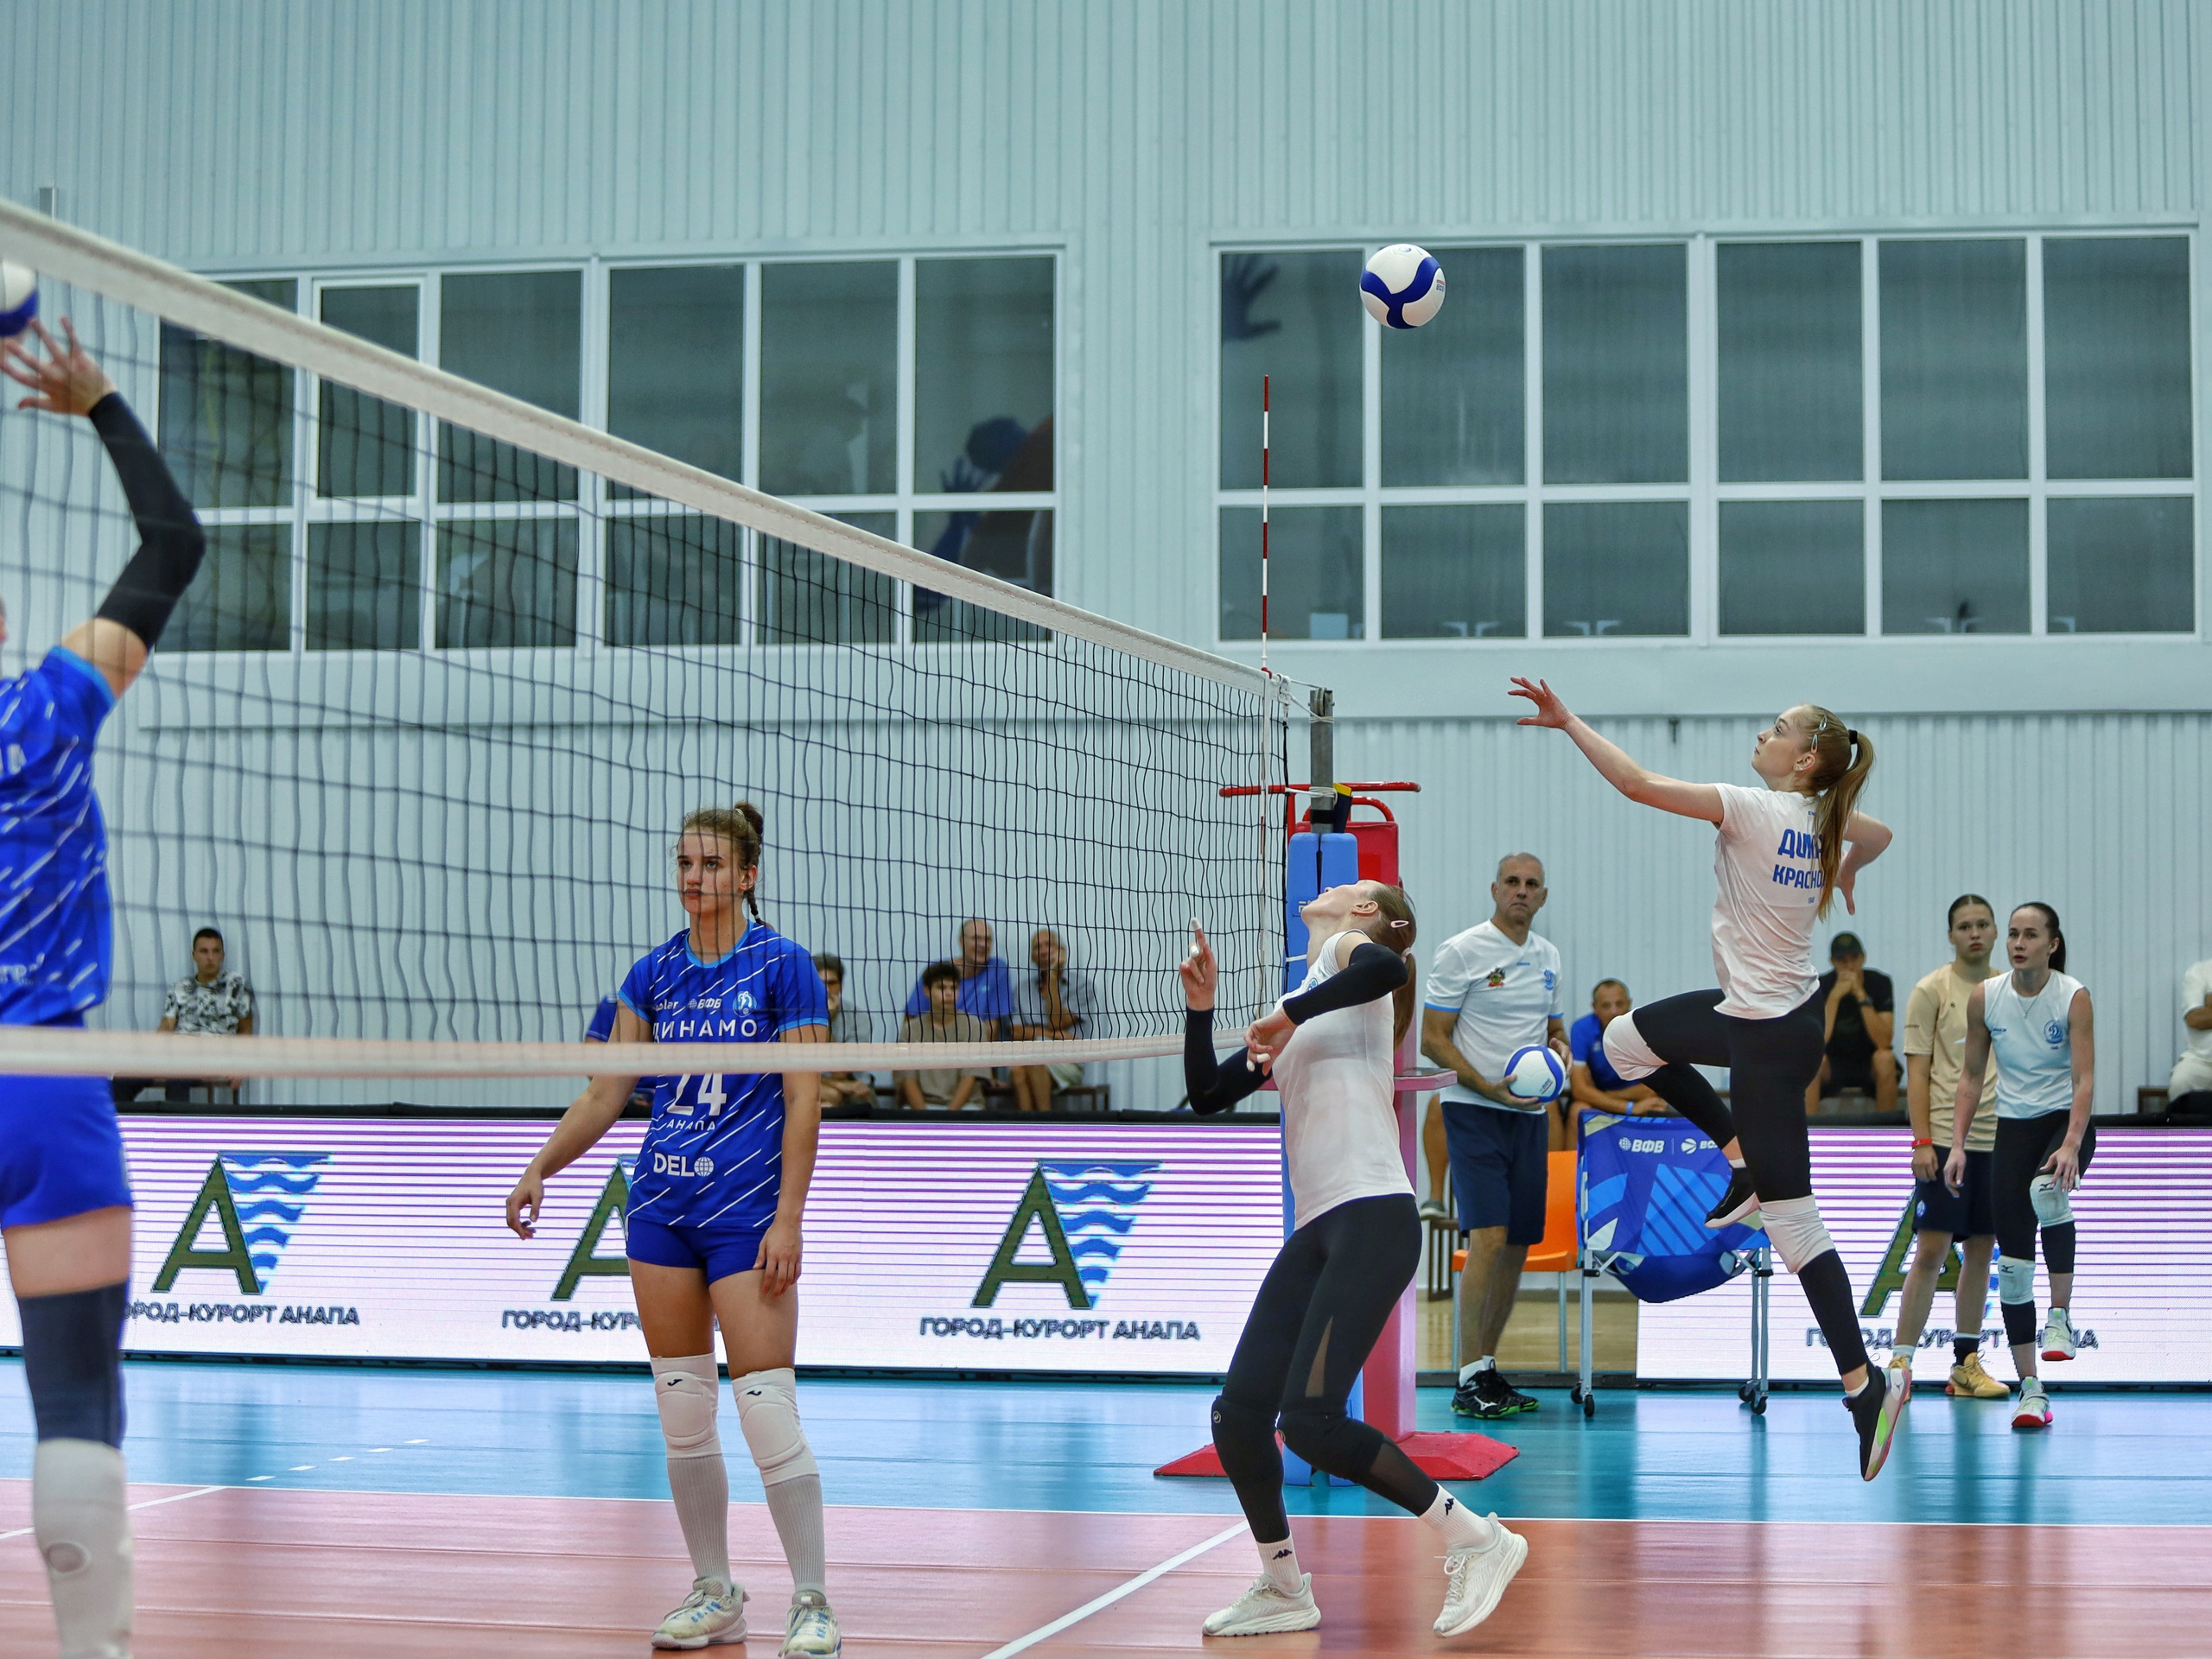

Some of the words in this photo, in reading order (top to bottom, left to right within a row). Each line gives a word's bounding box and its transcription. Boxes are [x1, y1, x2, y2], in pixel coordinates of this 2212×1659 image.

[1772, 864, 1825, 889] КРАСНО
[667, 1073, 728, 1116] 24
[666, 1119, 715, 1131] АНАПА
[1631, 1139, 1665, 1154] ВФВ
[125, 1301, 276, 1323] РОД-КУРОРТ
[279, 1306, 360, 1325] АНАПА
[502, 1309, 643, 1332] ГОРОД-КУР
[919, 1317, 1109, 1339] ГОРОД-КУРОРТ
[1112, 1320, 1201, 1339] АНАПА
